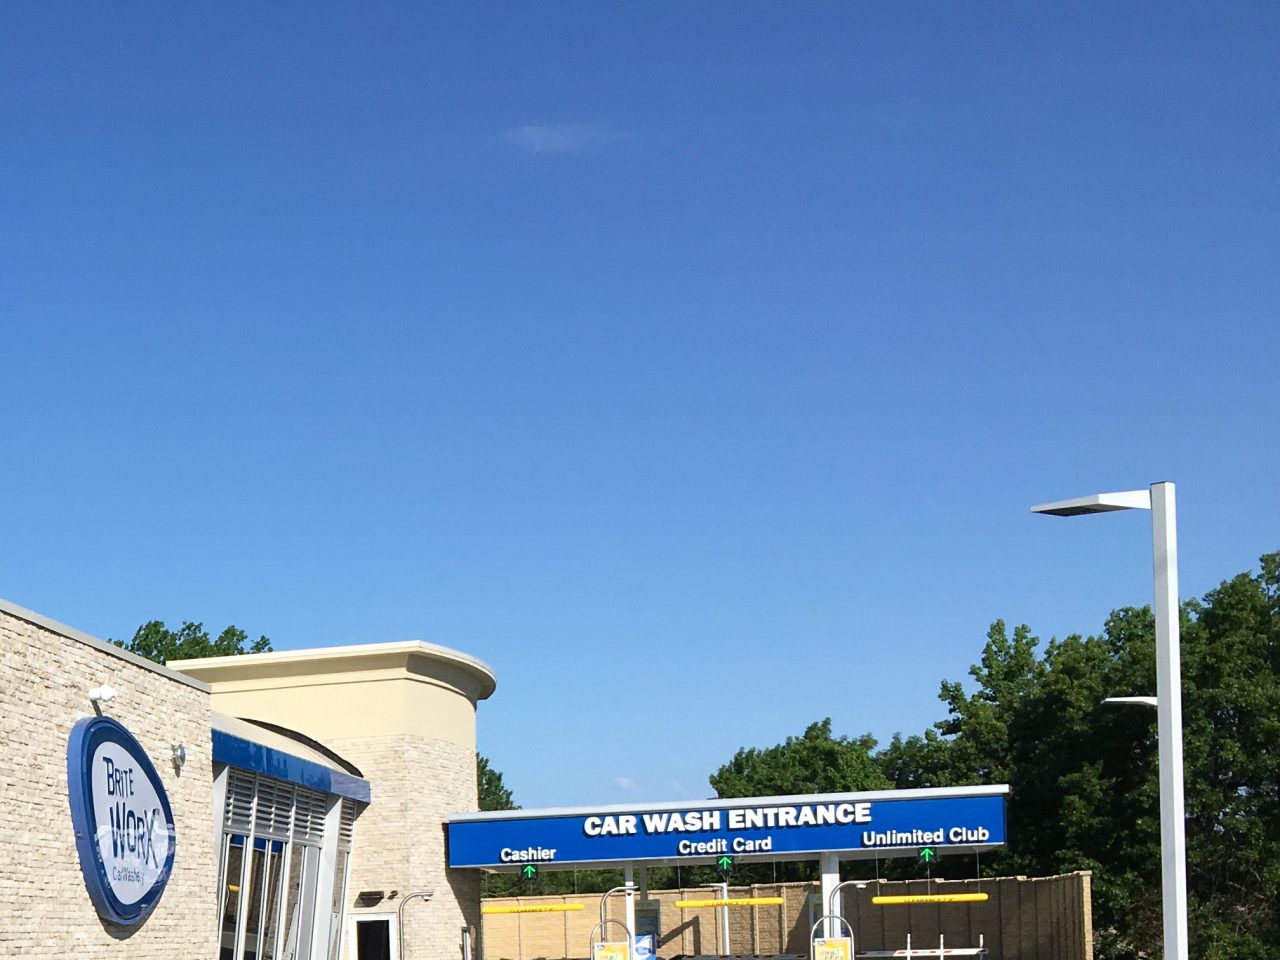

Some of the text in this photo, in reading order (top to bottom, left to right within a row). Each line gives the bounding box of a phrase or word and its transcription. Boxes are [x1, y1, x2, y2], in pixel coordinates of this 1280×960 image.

[583, 802, 872, 836] CAR WASH ENTRANCE
[863, 826, 990, 845] Unlimited Club
[500, 846, 557, 861] Cashier
[678, 836, 772, 854] Credit Card
